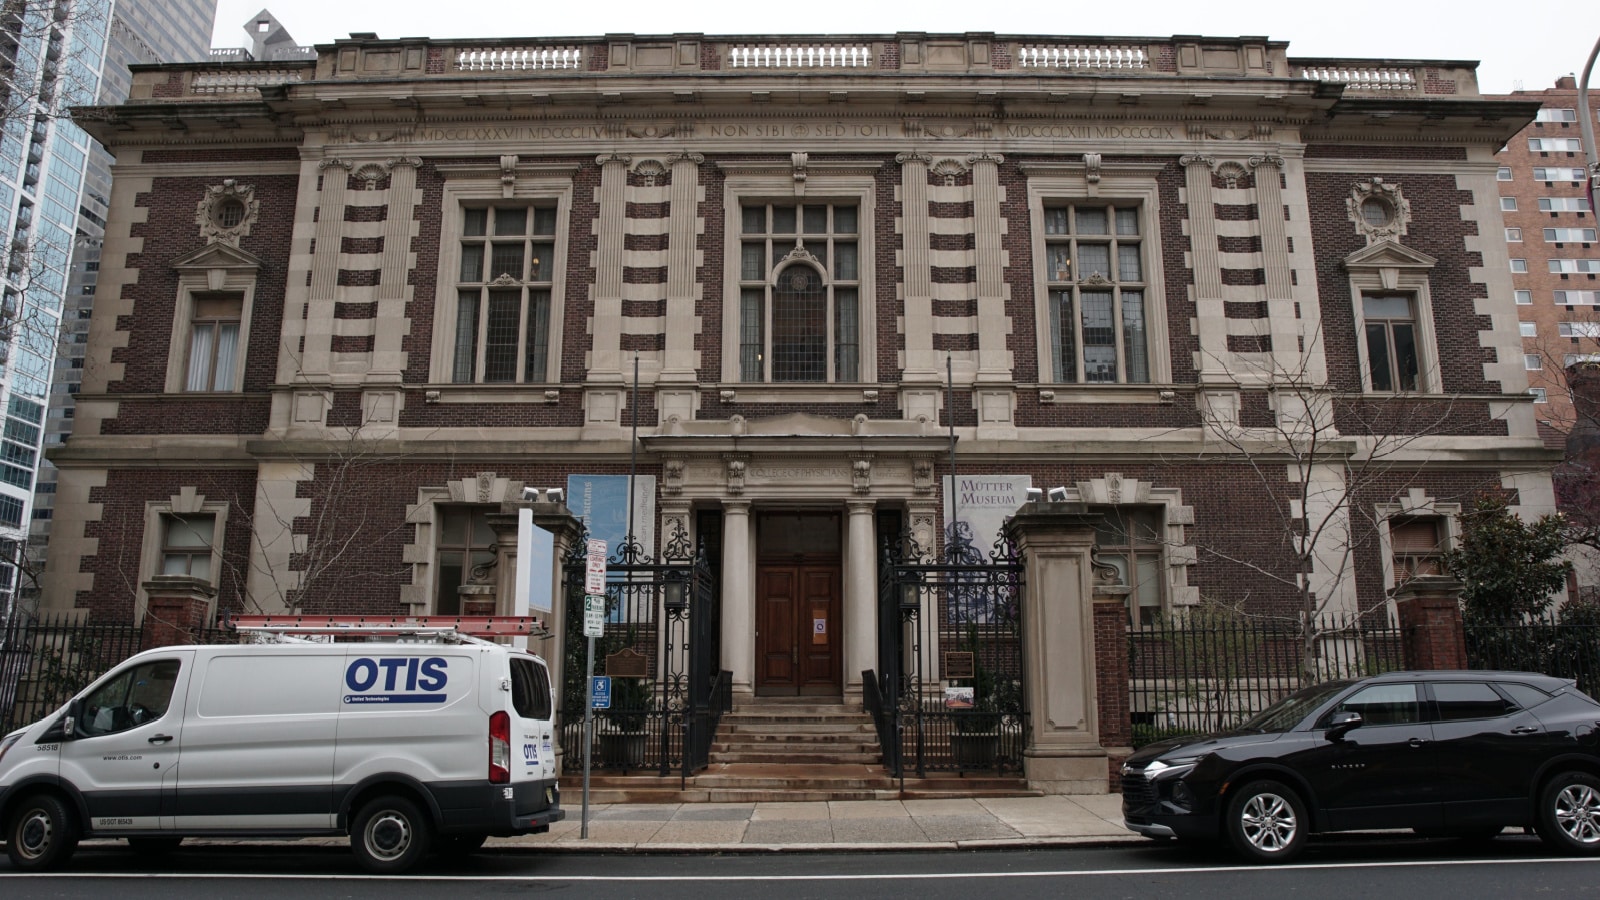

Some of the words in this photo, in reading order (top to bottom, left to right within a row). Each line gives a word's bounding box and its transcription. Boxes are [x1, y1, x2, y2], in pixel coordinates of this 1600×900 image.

[421, 127, 523, 141] MDCCLXXXVII
[529, 126, 603, 139] MDCCCLIV
[711, 125, 748, 137] NON
[755, 125, 785, 137] SIBI
[815, 125, 846, 137] SED
[851, 125, 889, 137] TOTI
[1006, 126, 1091, 139] MDCCCLXIII
[750, 468, 787, 478] COLLEGE
[788, 468, 800, 477] OF
[802, 468, 848, 478] PHYSICIANS
[961, 493, 1016, 505] MUSEUM
[586, 598, 591, 609] 2
[345, 657, 448, 692] OTIS
[523, 743, 538, 760] OTIS
